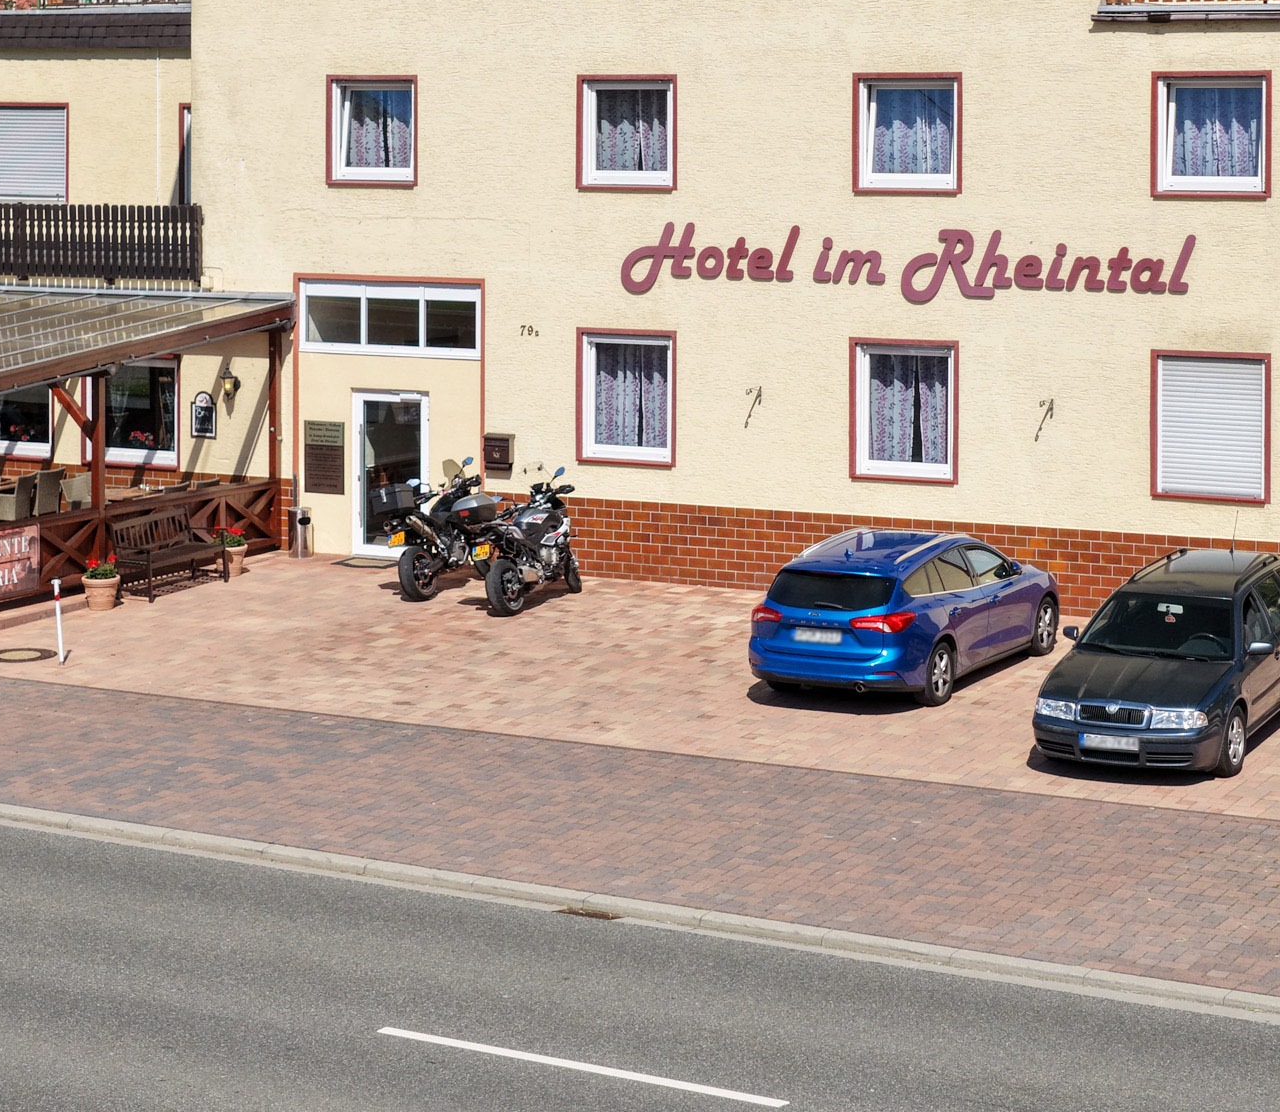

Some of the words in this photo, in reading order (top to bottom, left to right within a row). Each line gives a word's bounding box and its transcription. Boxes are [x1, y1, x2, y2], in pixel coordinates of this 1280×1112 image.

[620, 221, 801, 296] Hotel
[812, 237, 886, 285] im
[900, 228, 1197, 304] Rheintal
